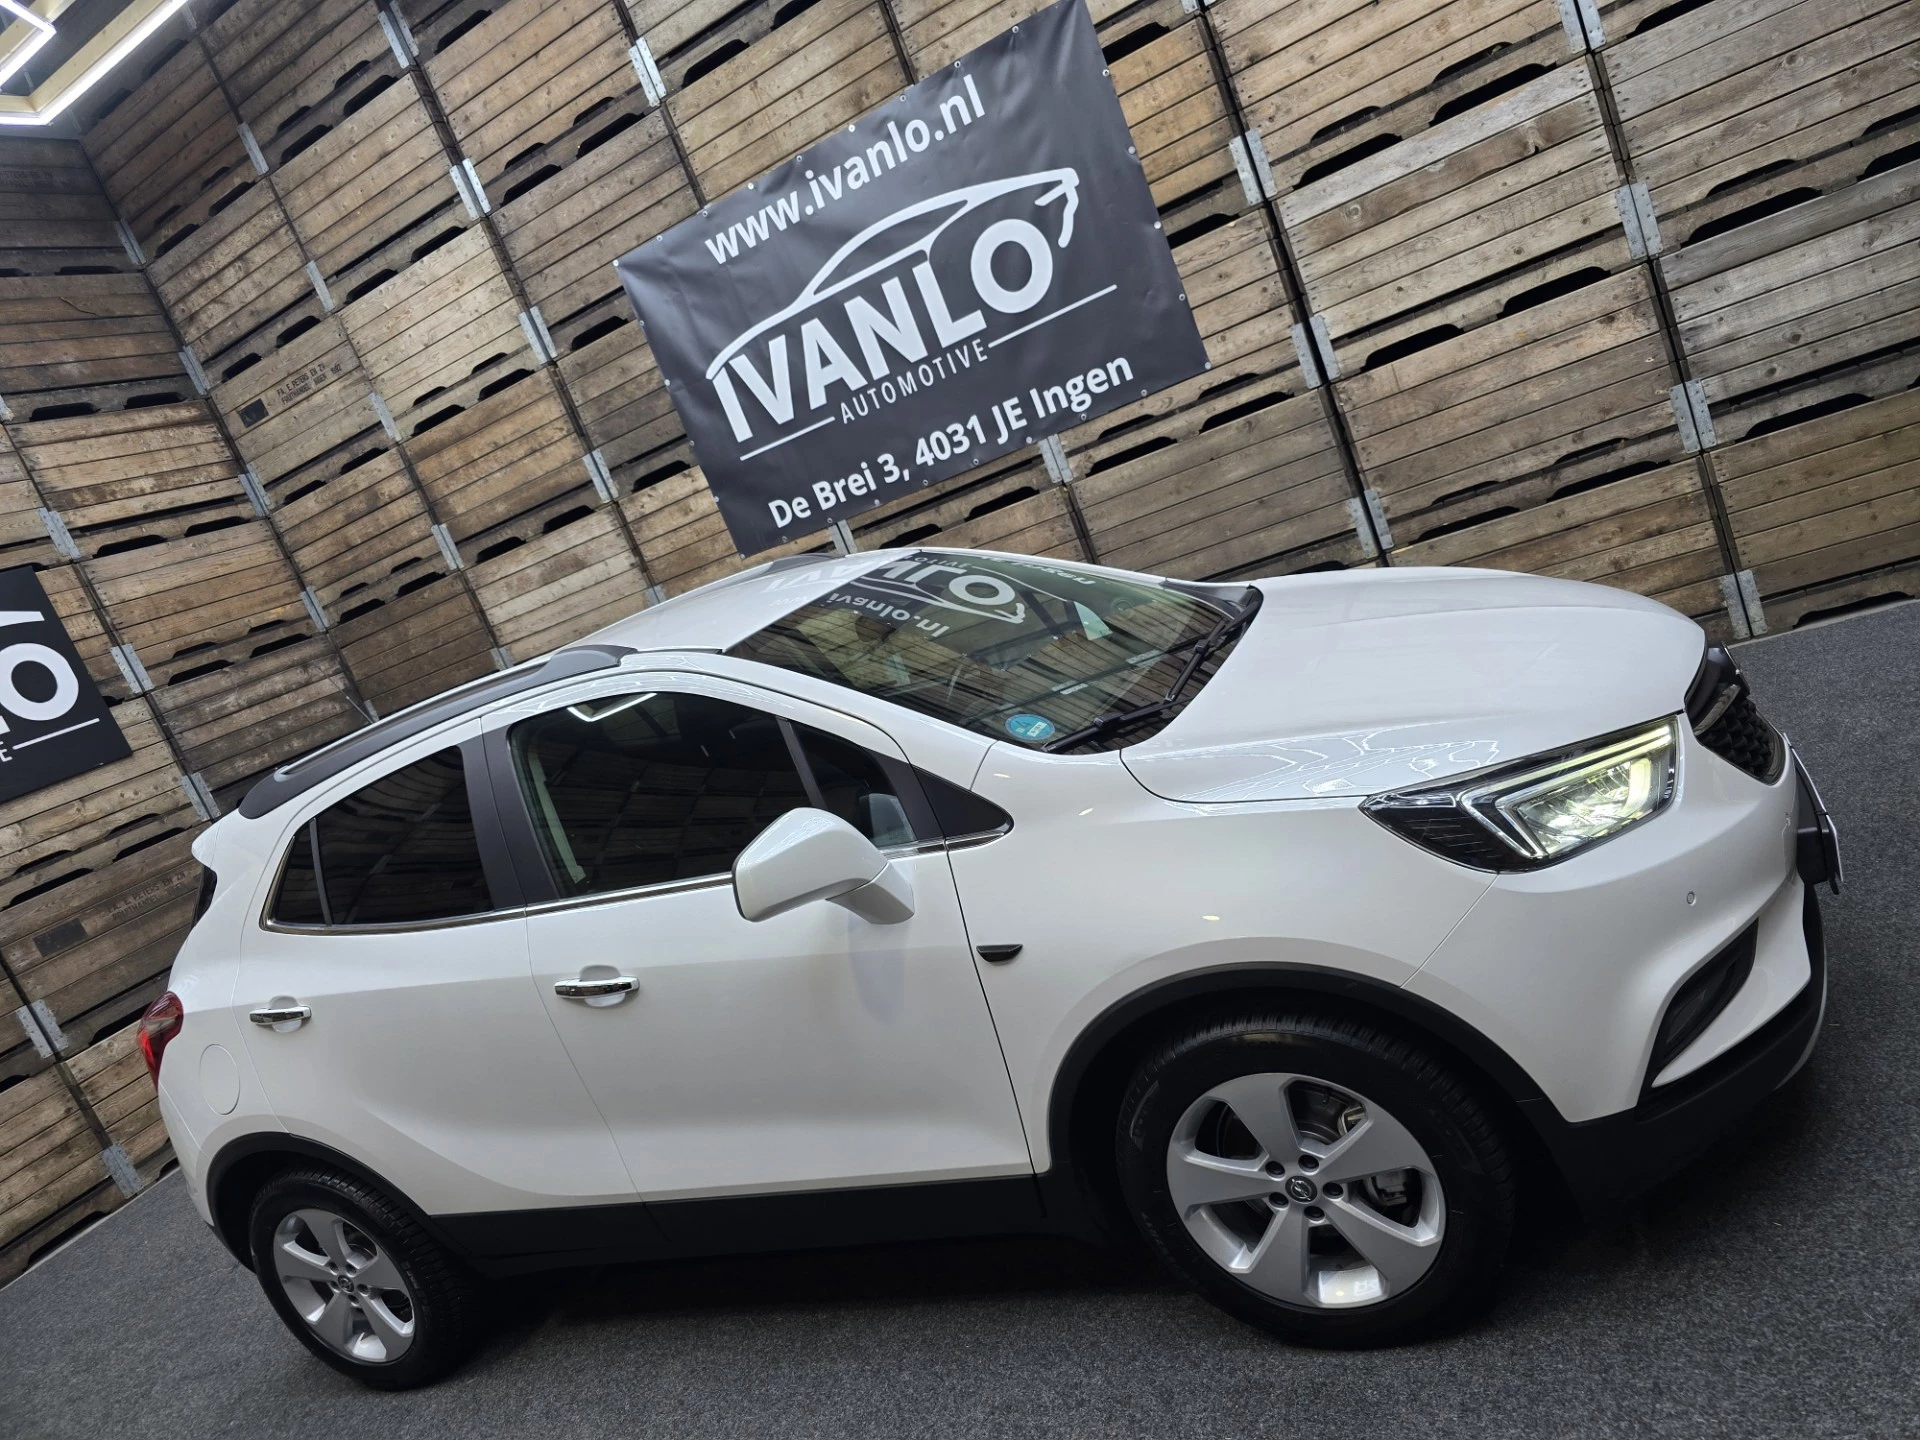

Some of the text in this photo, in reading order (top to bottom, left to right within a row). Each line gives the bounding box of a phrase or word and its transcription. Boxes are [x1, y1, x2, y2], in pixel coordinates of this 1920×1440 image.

[704, 74, 985, 264] www.ivanlo.nl
[712, 218, 1053, 443] IVANLO
[840, 338, 988, 424] AUTOMOTIVE
[768, 356, 1135, 528] De Brei 3, 4031 JE Ingen
